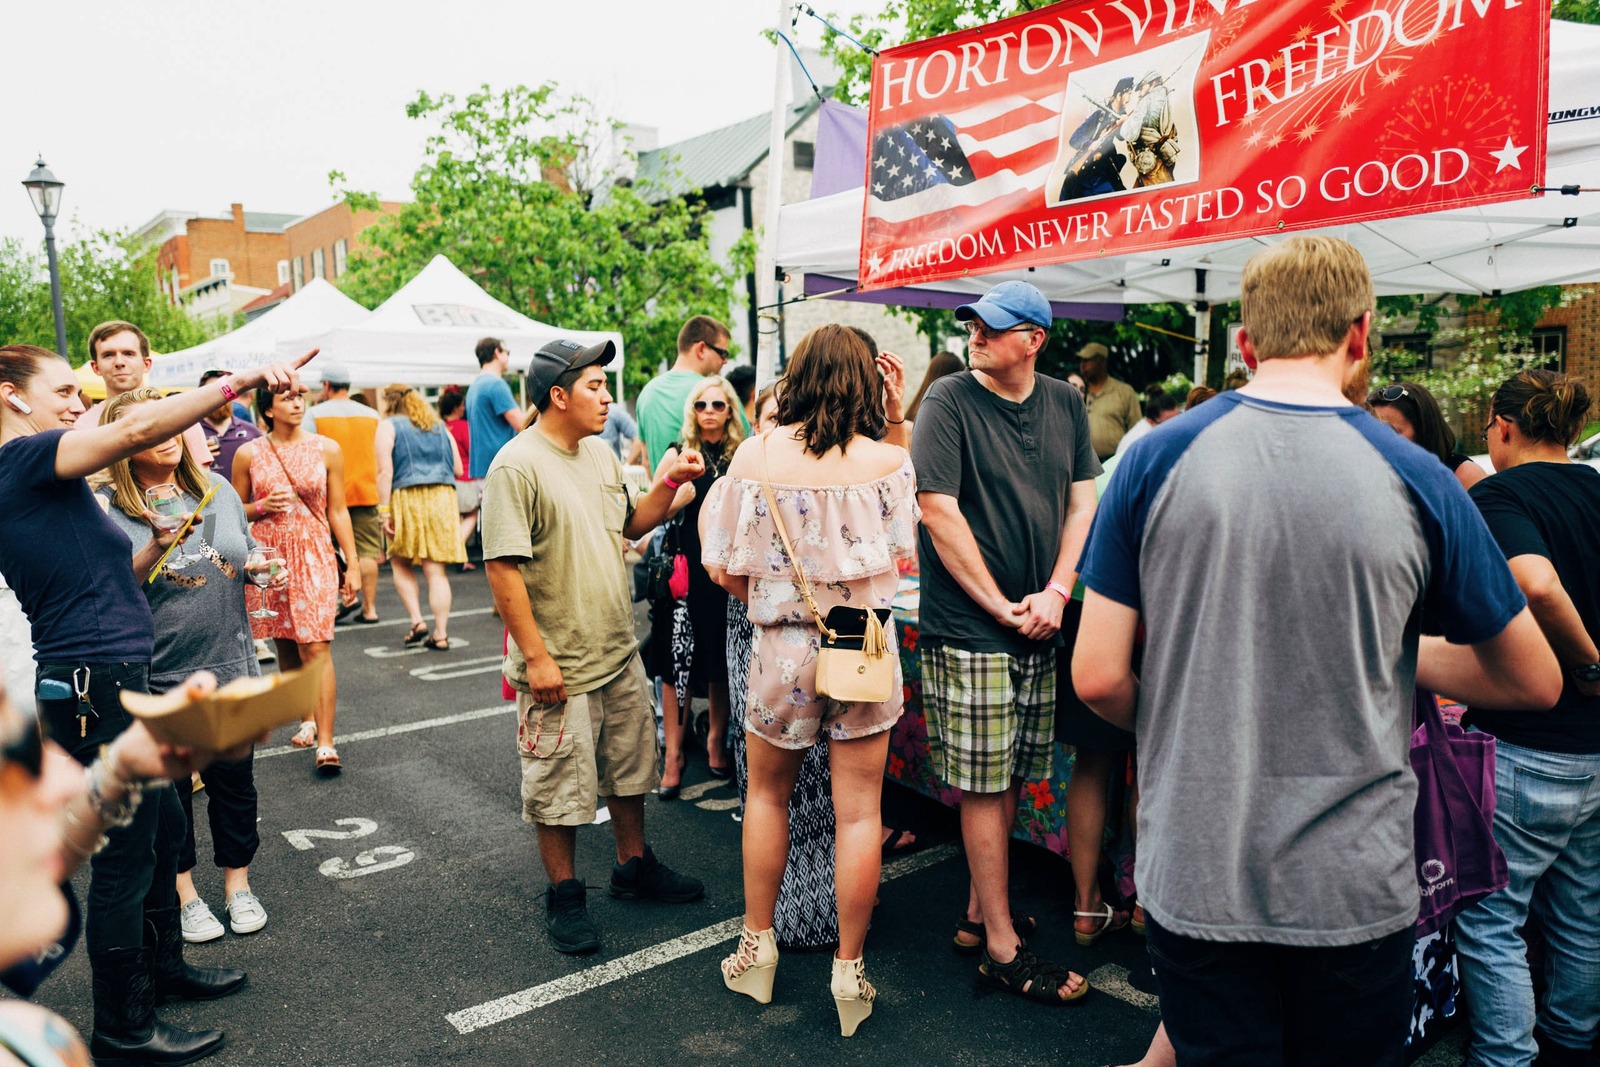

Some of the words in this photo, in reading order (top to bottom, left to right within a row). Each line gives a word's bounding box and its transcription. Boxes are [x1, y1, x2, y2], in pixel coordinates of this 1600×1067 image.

[880, 9, 1103, 111] HORTON
[1106, 0, 1259, 46] VI
[890, 229, 1005, 272] FREEDOM
[1013, 211, 1110, 253] NEVER
[1119, 187, 1245, 236] TASTED
[1256, 175, 1307, 214] SO
[1319, 148, 1469, 202] GOOD
[281, 817, 415, 879] 29
